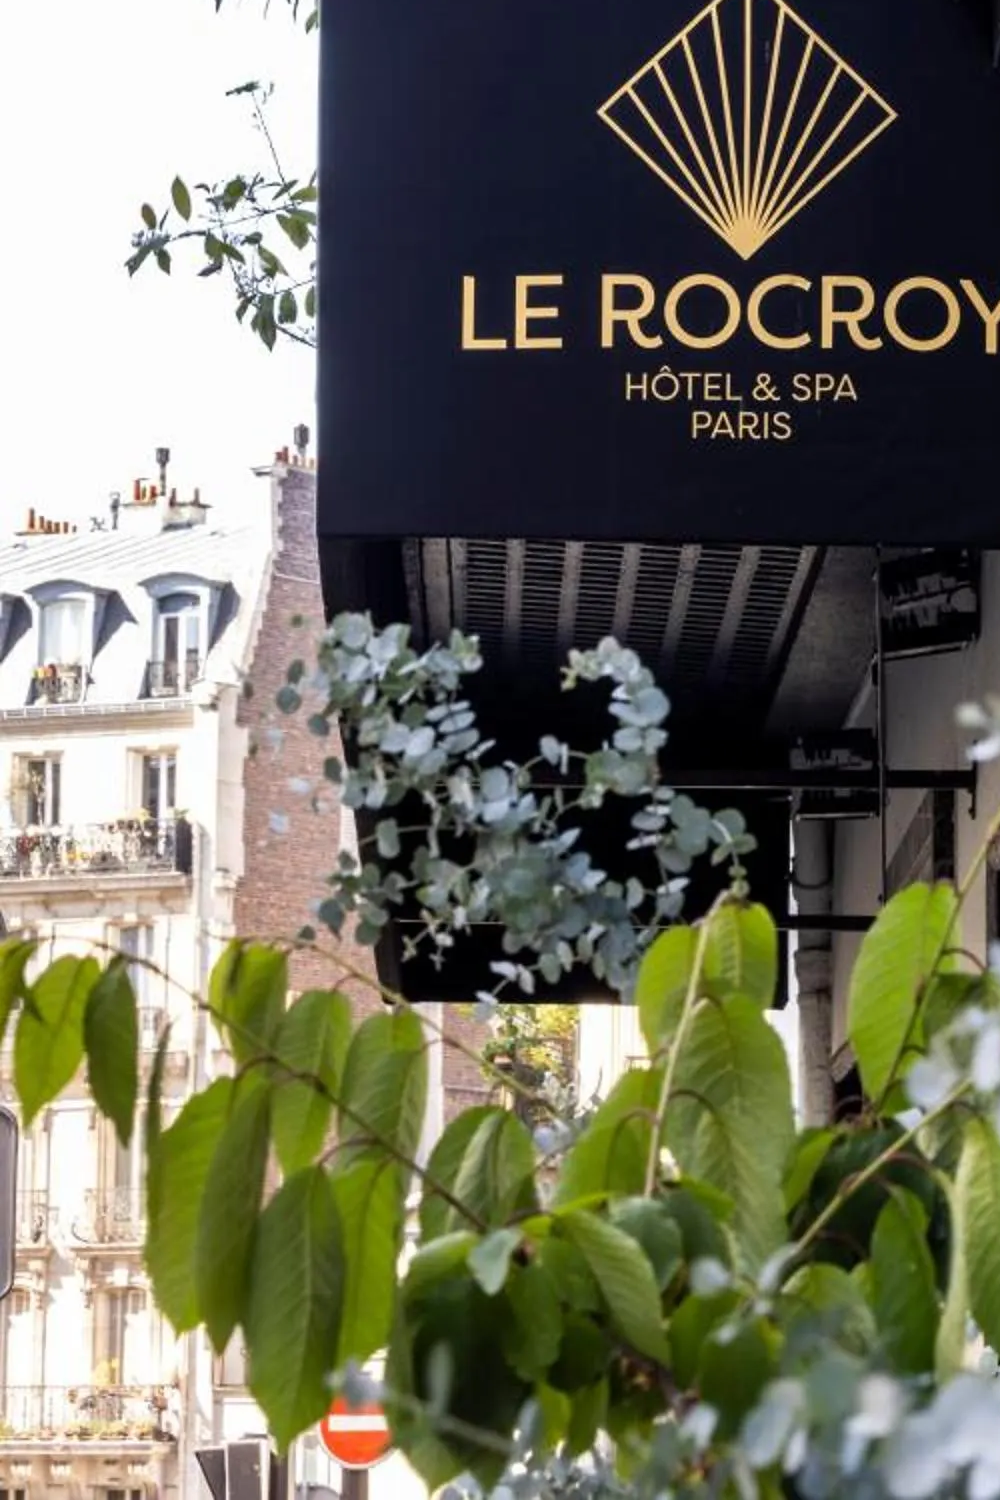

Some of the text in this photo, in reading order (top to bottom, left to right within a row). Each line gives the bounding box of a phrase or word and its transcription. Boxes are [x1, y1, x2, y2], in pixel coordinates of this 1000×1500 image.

[461, 275, 564, 349] LE
[625, 365, 857, 402] HÔTEL & SPA
[691, 411, 792, 440] PARIS
